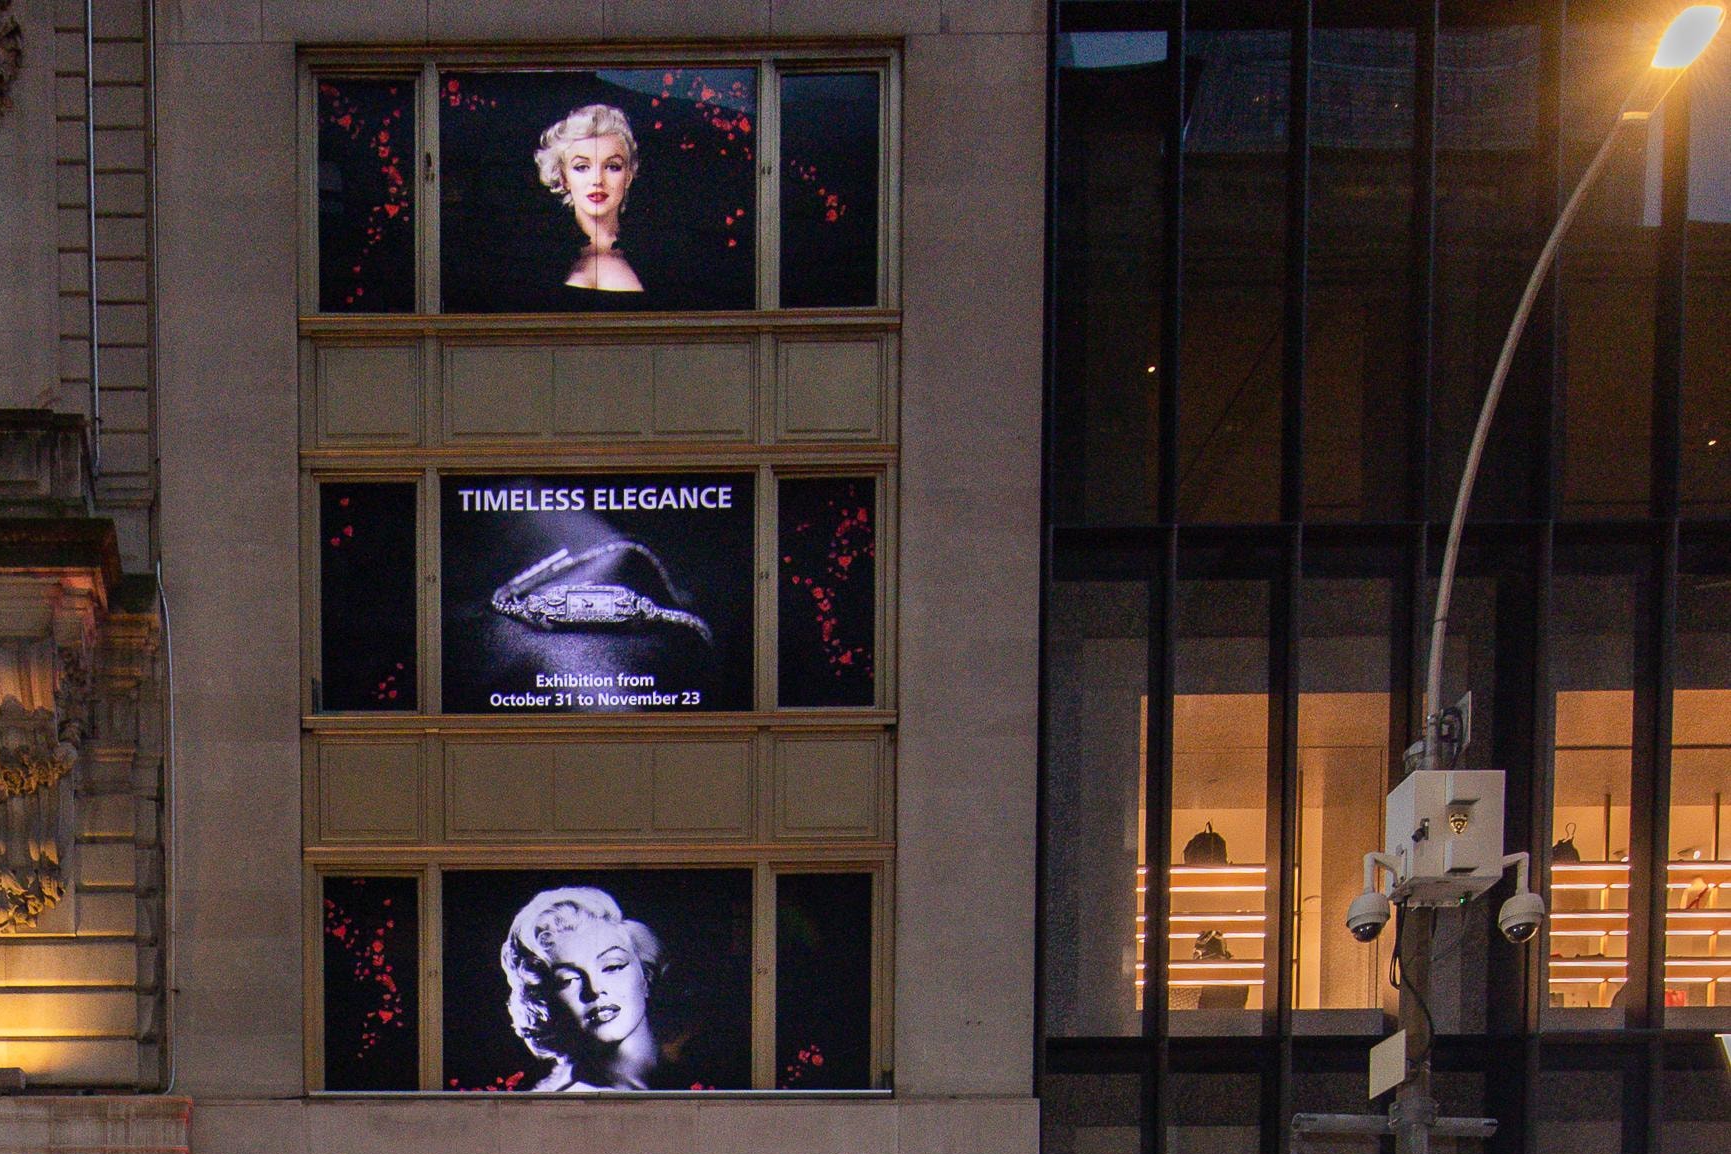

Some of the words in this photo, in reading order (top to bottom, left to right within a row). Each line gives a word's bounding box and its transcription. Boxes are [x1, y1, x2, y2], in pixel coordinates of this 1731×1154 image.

[458, 488, 585, 511] TIMELESS
[594, 486, 733, 510] ELEGANCE
[535, 674, 614, 688] Exhibition
[617, 673, 655, 687] from
[490, 692, 552, 707] October
[555, 693, 574, 706] 31
[577, 693, 594, 706] to
[598, 690, 679, 706] November
[681, 692, 701, 705] 23
